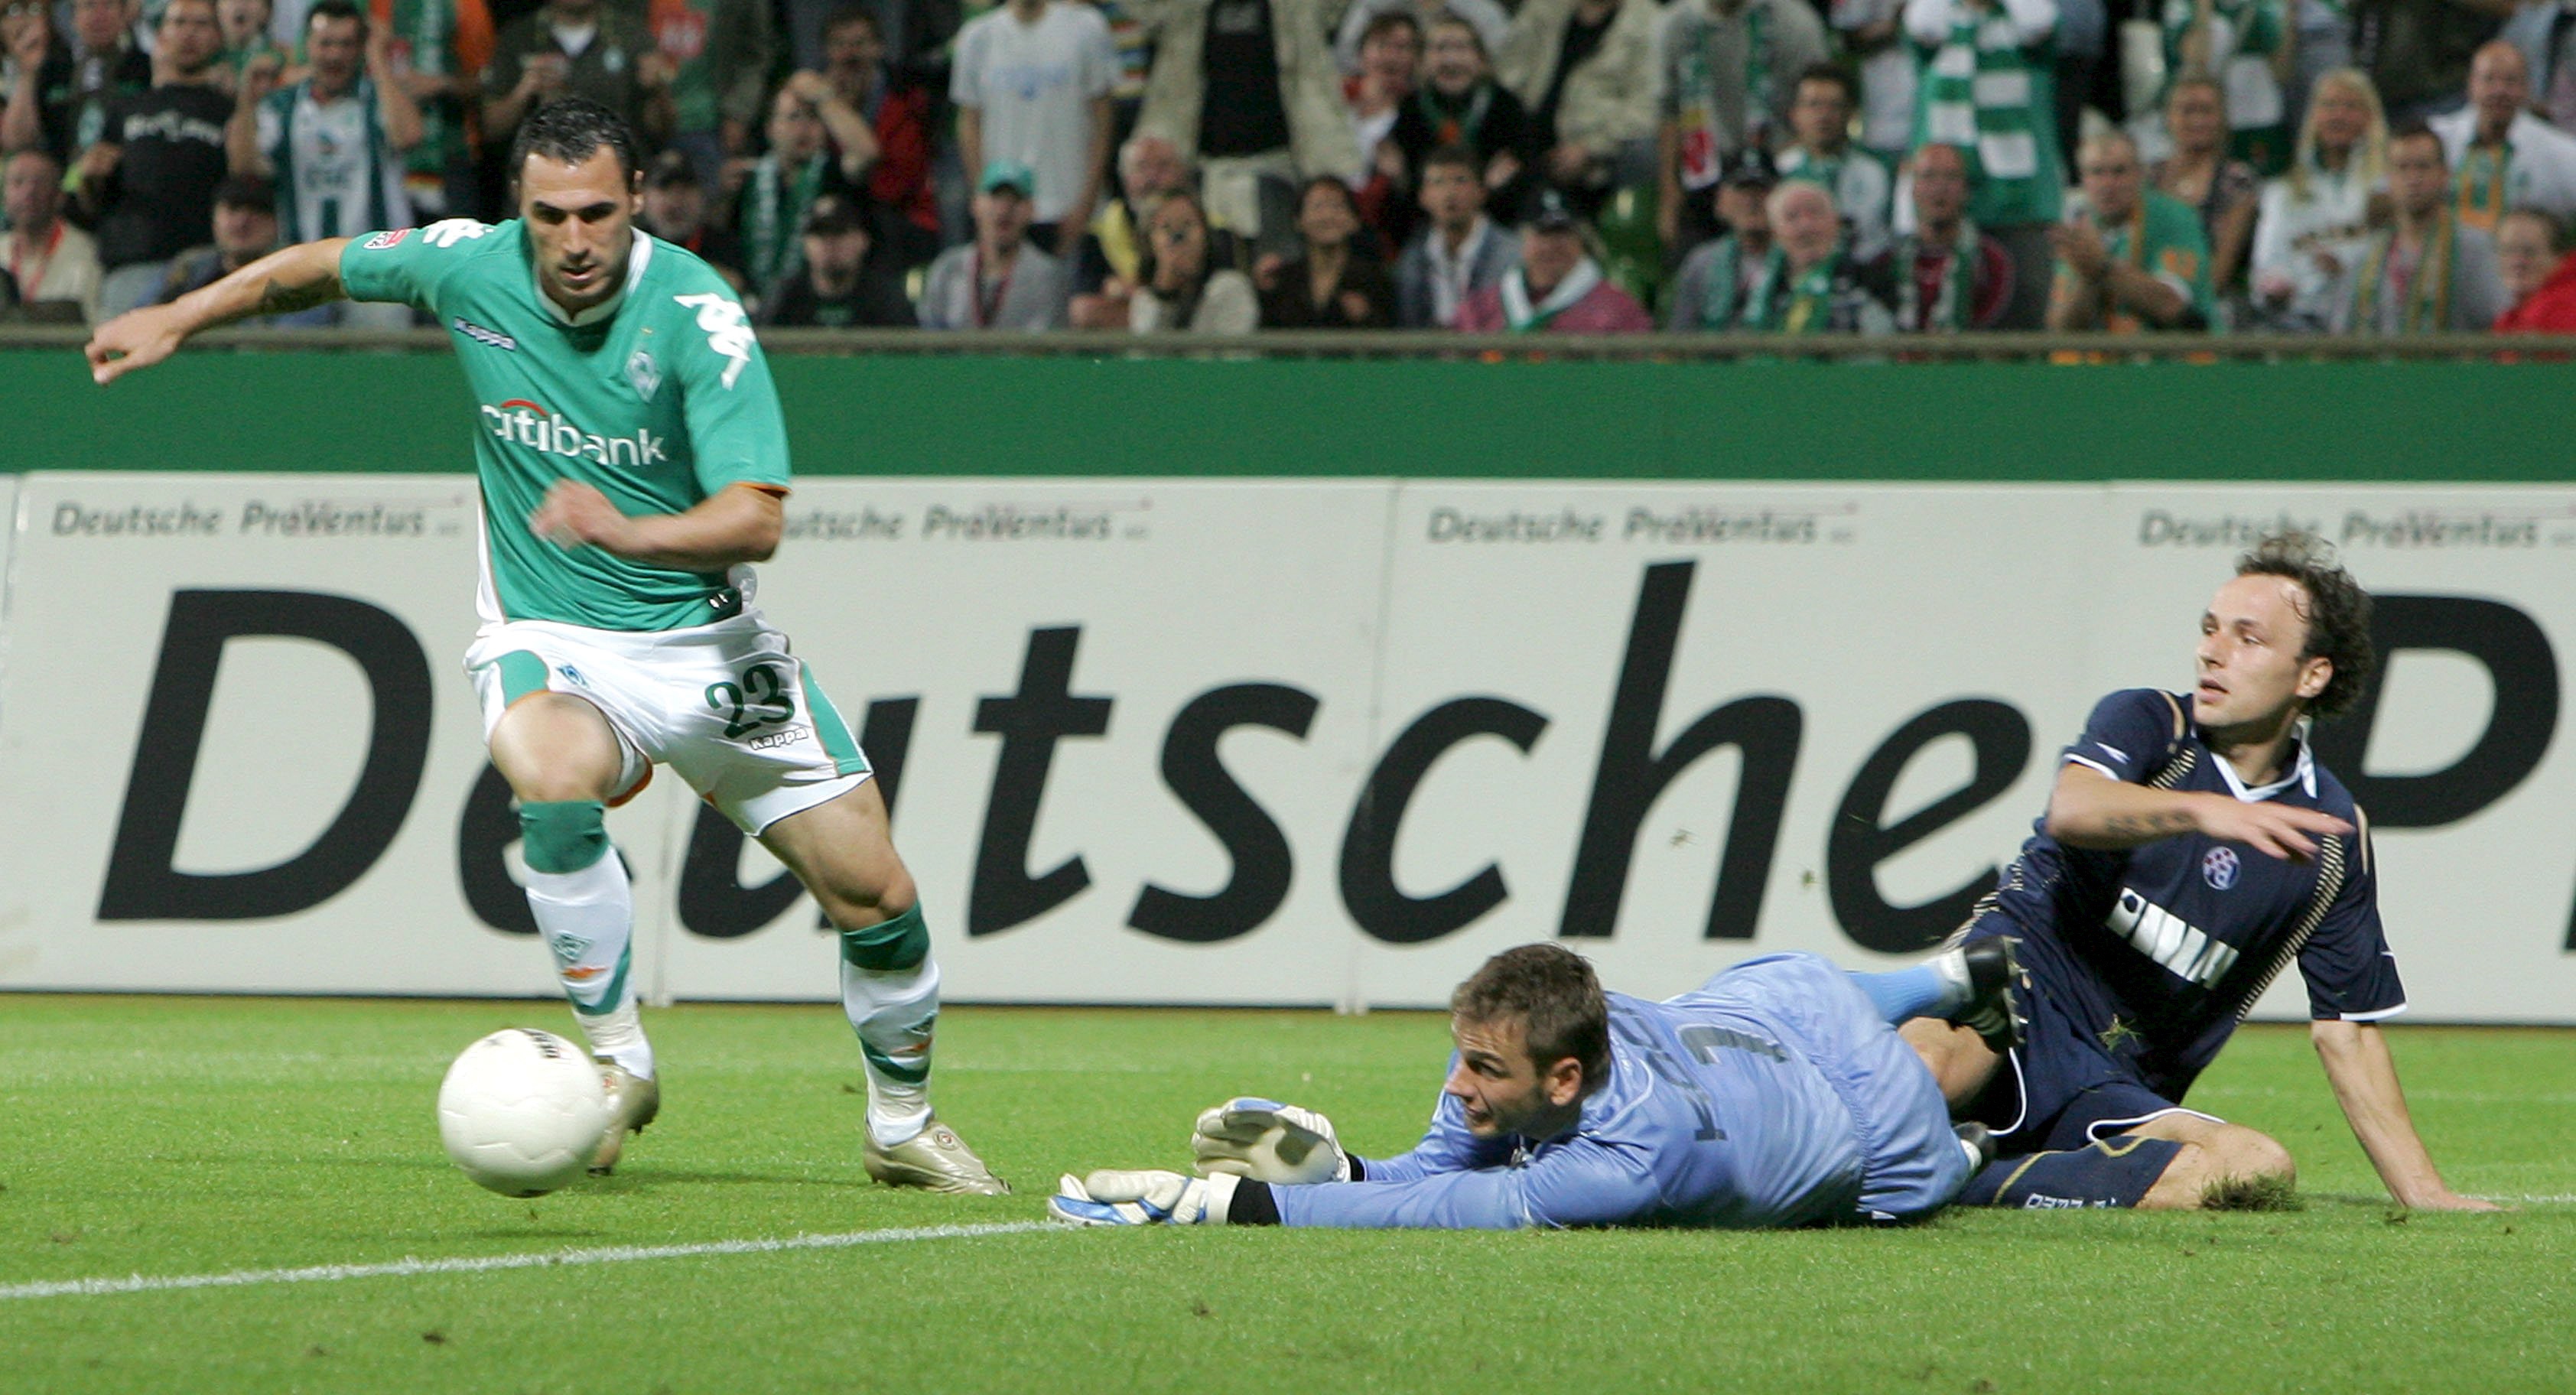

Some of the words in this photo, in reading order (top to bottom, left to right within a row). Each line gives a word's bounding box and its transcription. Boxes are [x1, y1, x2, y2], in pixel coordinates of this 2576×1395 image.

[481, 404, 668, 466] citibank
[53, 501, 220, 535] Deutsche
[783, 505, 905, 539] utsche
[1428, 507, 1605, 542] Deutsche
[704, 664, 795, 739] 23
[750, 727, 808, 750] Kappa
[1677, 1023, 1788, 1064] 1
